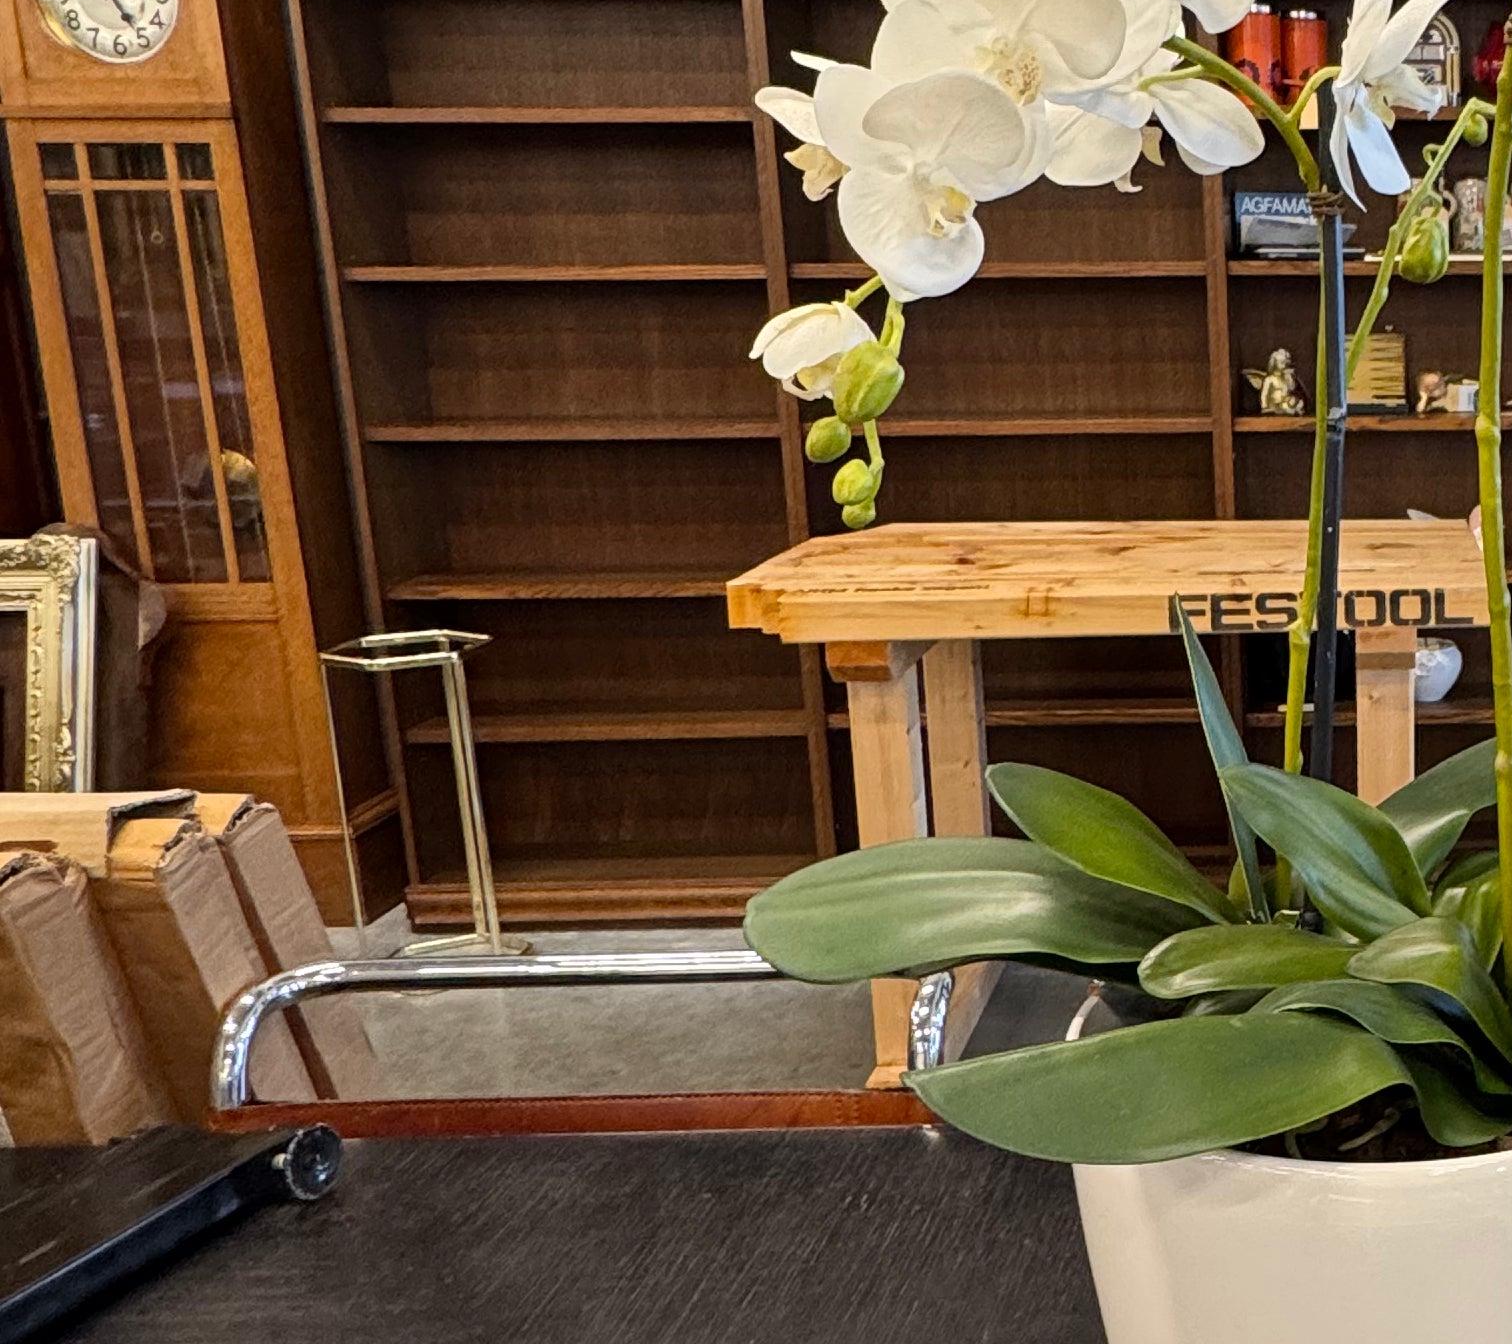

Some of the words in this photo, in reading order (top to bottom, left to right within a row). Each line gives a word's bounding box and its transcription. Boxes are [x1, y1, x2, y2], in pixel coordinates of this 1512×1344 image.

[66, 9, 80, 30] 8
[150, 9, 166, 30] 4
[86, 28, 100, 49] 7
[113, 34, 127, 56] 6
[136, 27, 150, 48] 5
[1168, 589, 1474, 632] FESOOL
